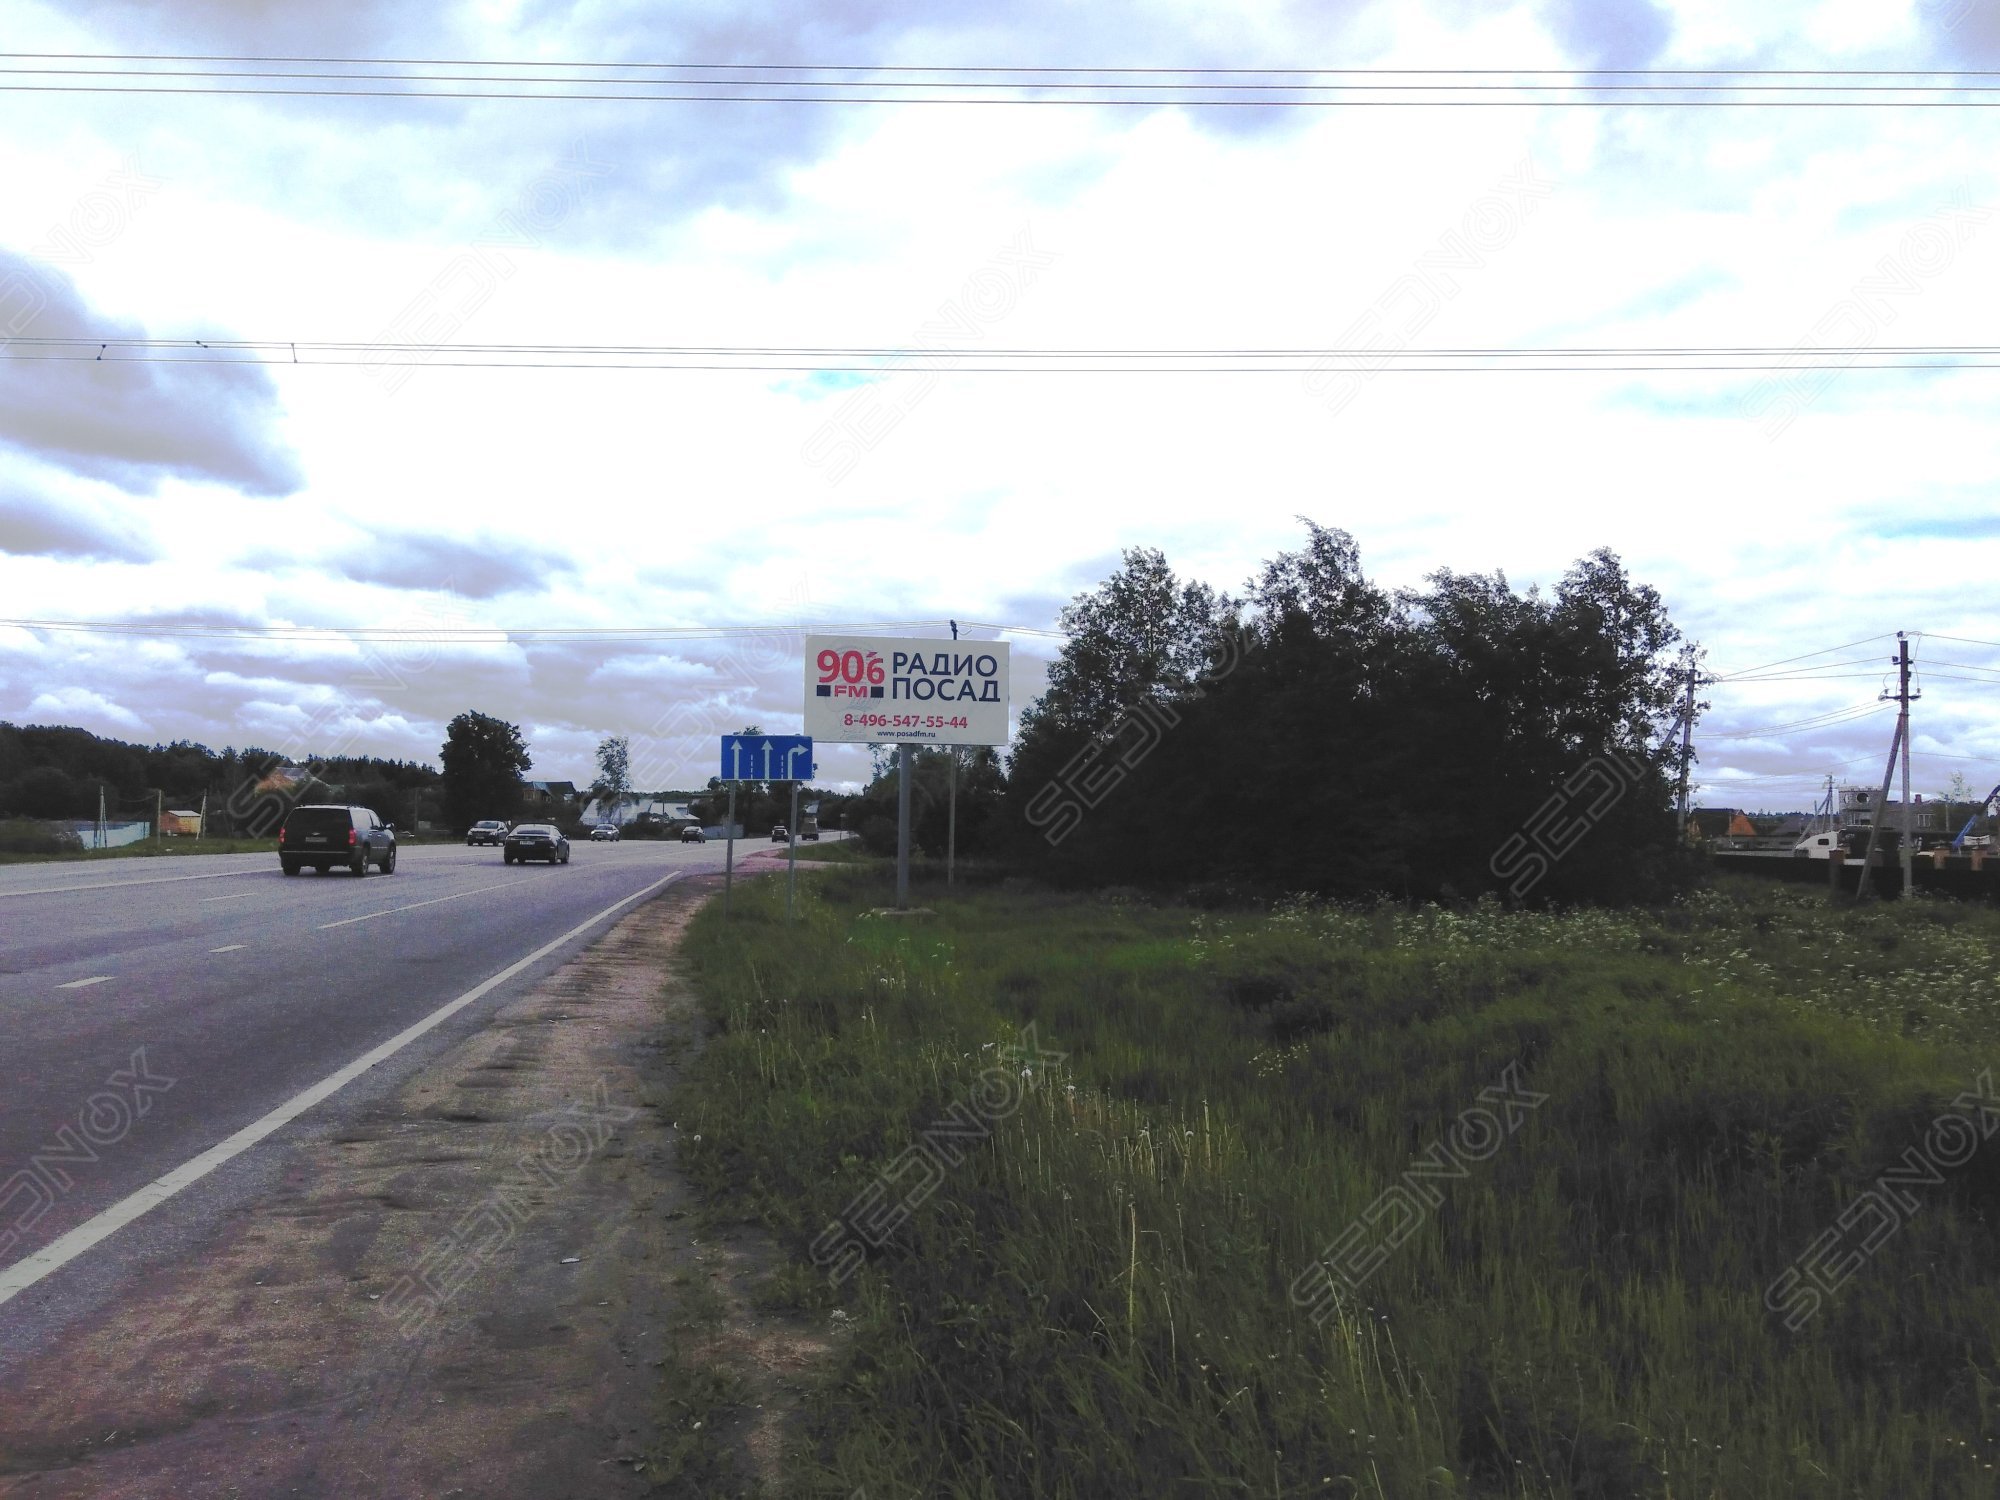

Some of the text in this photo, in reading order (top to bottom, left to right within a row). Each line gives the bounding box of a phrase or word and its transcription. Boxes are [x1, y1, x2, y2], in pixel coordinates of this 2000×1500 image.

[892, 651, 998, 677] РАДИО
[833, 685, 868, 698] FM
[892, 677, 1001, 702] ПОСАД
[843, 713, 968, 729] 8-496-547-55-44
[876, 730, 936, 739] www.posadfm.ru
